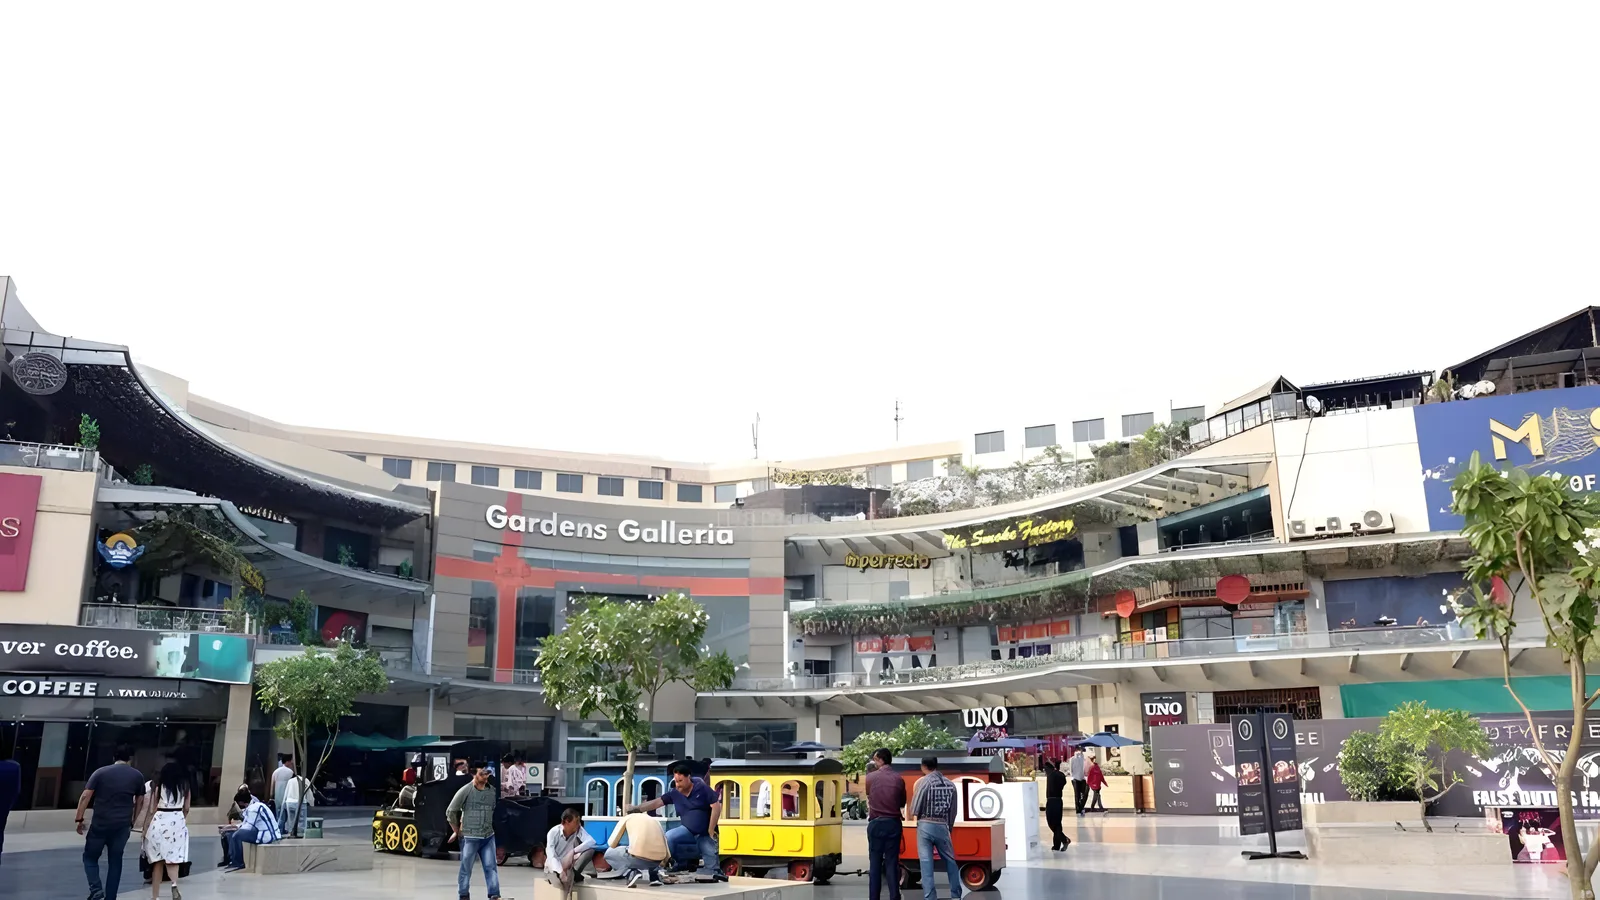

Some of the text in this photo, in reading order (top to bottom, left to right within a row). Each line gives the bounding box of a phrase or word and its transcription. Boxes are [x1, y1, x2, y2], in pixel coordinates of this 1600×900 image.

[485, 504, 735, 545] Gardens Galleria
[1018, 518, 1075, 540] Factory
[54, 639, 139, 659] coffee.
[2, 679, 98, 697] COFFEE
[961, 706, 1009, 728] UNO
[1144, 702, 1183, 716] UNO
[1472, 790, 1518, 806] FALSE
[1520, 790, 1578, 807] DUTIS
